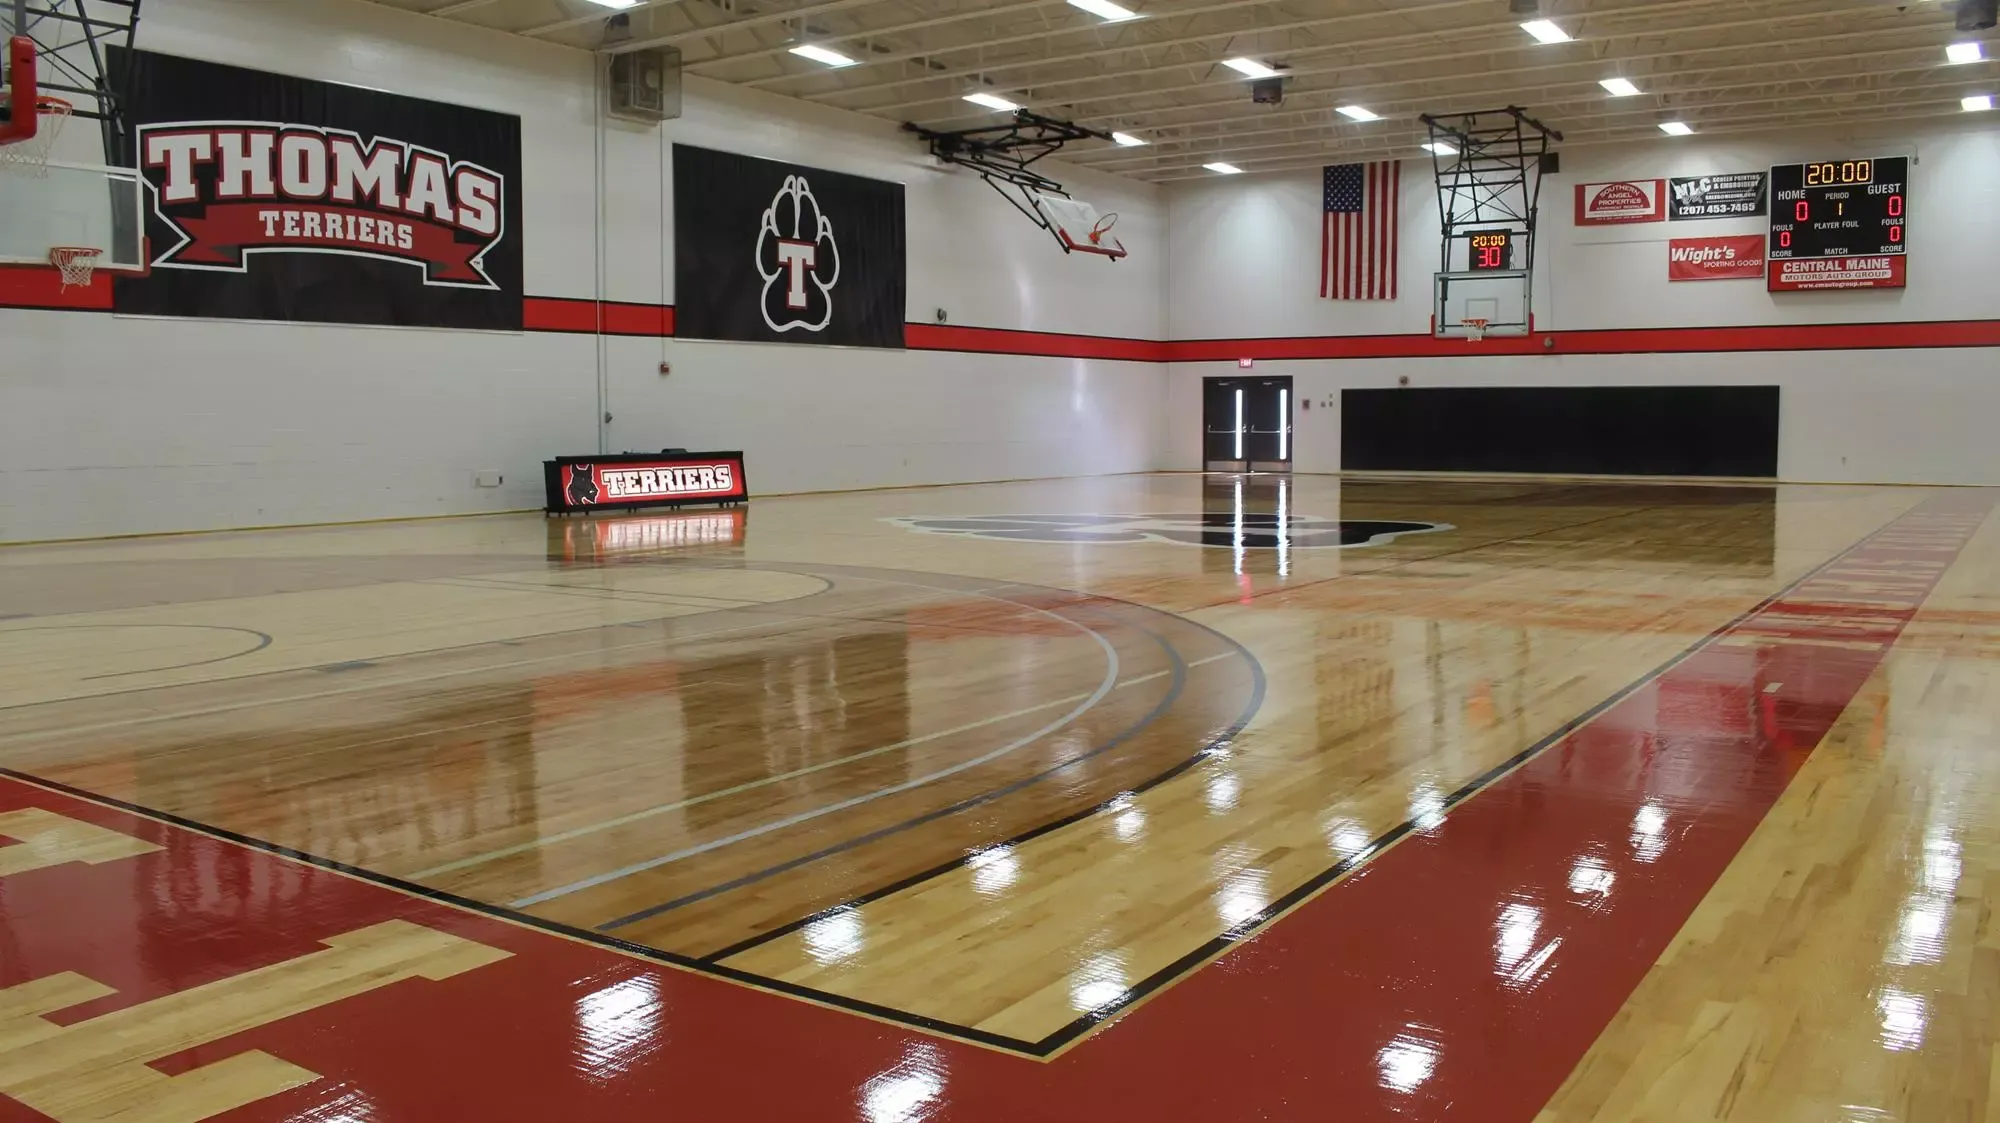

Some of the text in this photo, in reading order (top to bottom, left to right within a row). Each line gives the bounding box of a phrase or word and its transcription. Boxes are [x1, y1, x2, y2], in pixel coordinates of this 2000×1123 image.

[1808, 162, 1869, 184] 20:00
[147, 131, 498, 236] THOMAS
[1674, 178, 1711, 200] NLC
[1867, 184, 1901, 195] GUEST
[1600, 185, 1640, 198] SOUTHERN
[1778, 190, 1806, 200] HOME
[1825, 192, 1849, 200] PERIOD
[1679, 205, 1704, 215] (207)
[1796, 201, 1808, 221] 0
[1889, 196, 1901, 216] 0
[1881, 218, 1903, 226] FOULS
[259, 210, 412, 250] TERRIERS
[1890, 226, 1900, 241] 0
[1472, 235, 1505, 247] 20:00
[1780, 232, 1790, 247] 0
[1671, 245, 1735, 264] Wight's
[1771, 250, 1792, 258] SCORE
[1880, 245, 1903, 253] SCORE
[1478, 247, 1500, 267] 30
[1704, 260, 1735, 268] SPORTING
[1783, 258, 1890, 273] CENTRAL MAINE
[777, 239, 818, 309] T
[1785, 271, 1888, 281] MOTORS AUTO GROUP
[603, 466, 731, 496] TERRIERS
